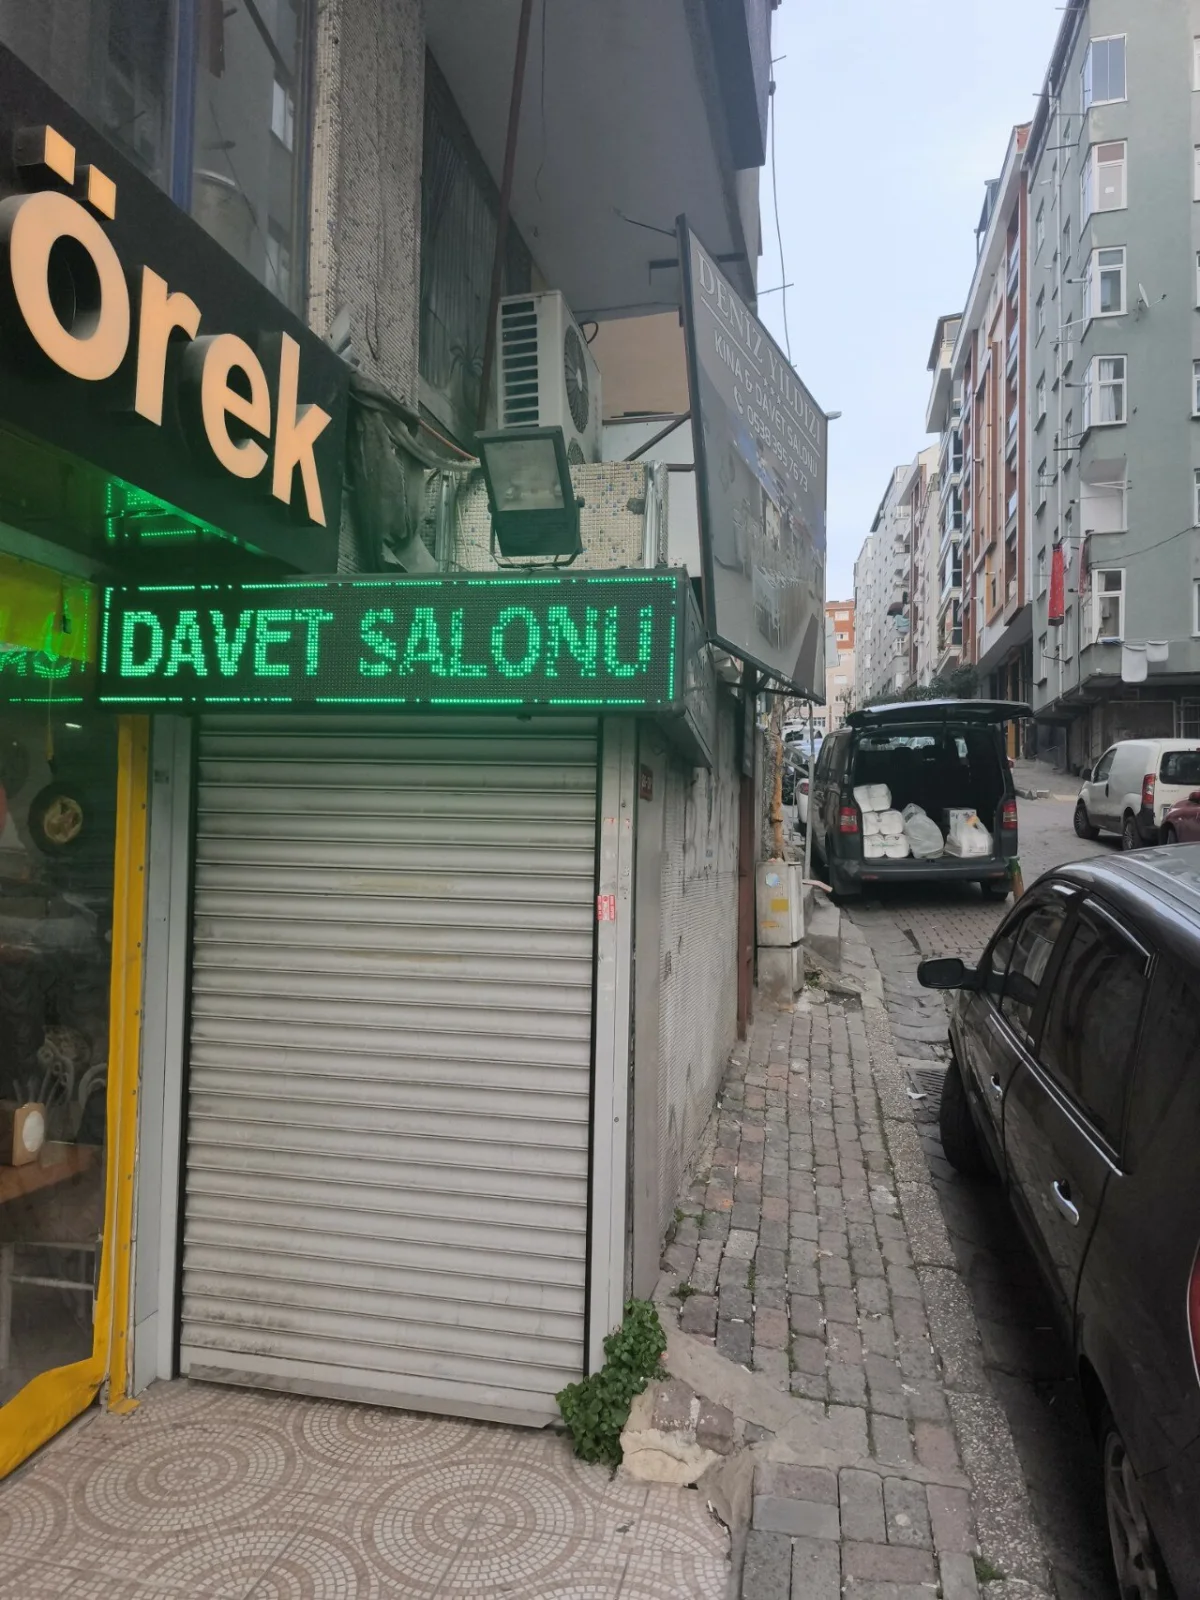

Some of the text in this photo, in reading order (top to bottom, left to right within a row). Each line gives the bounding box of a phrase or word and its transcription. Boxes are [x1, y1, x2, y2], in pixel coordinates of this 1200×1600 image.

[697, 250, 821, 446] DENİZ YILDIZI
[714, 330, 818, 478] KINA & DAVET SALONU
[747, 405, 808, 492] 0538 395 76 73
[120, 610, 333, 677] DAVET
[359, 606, 652, 677] SALONU
